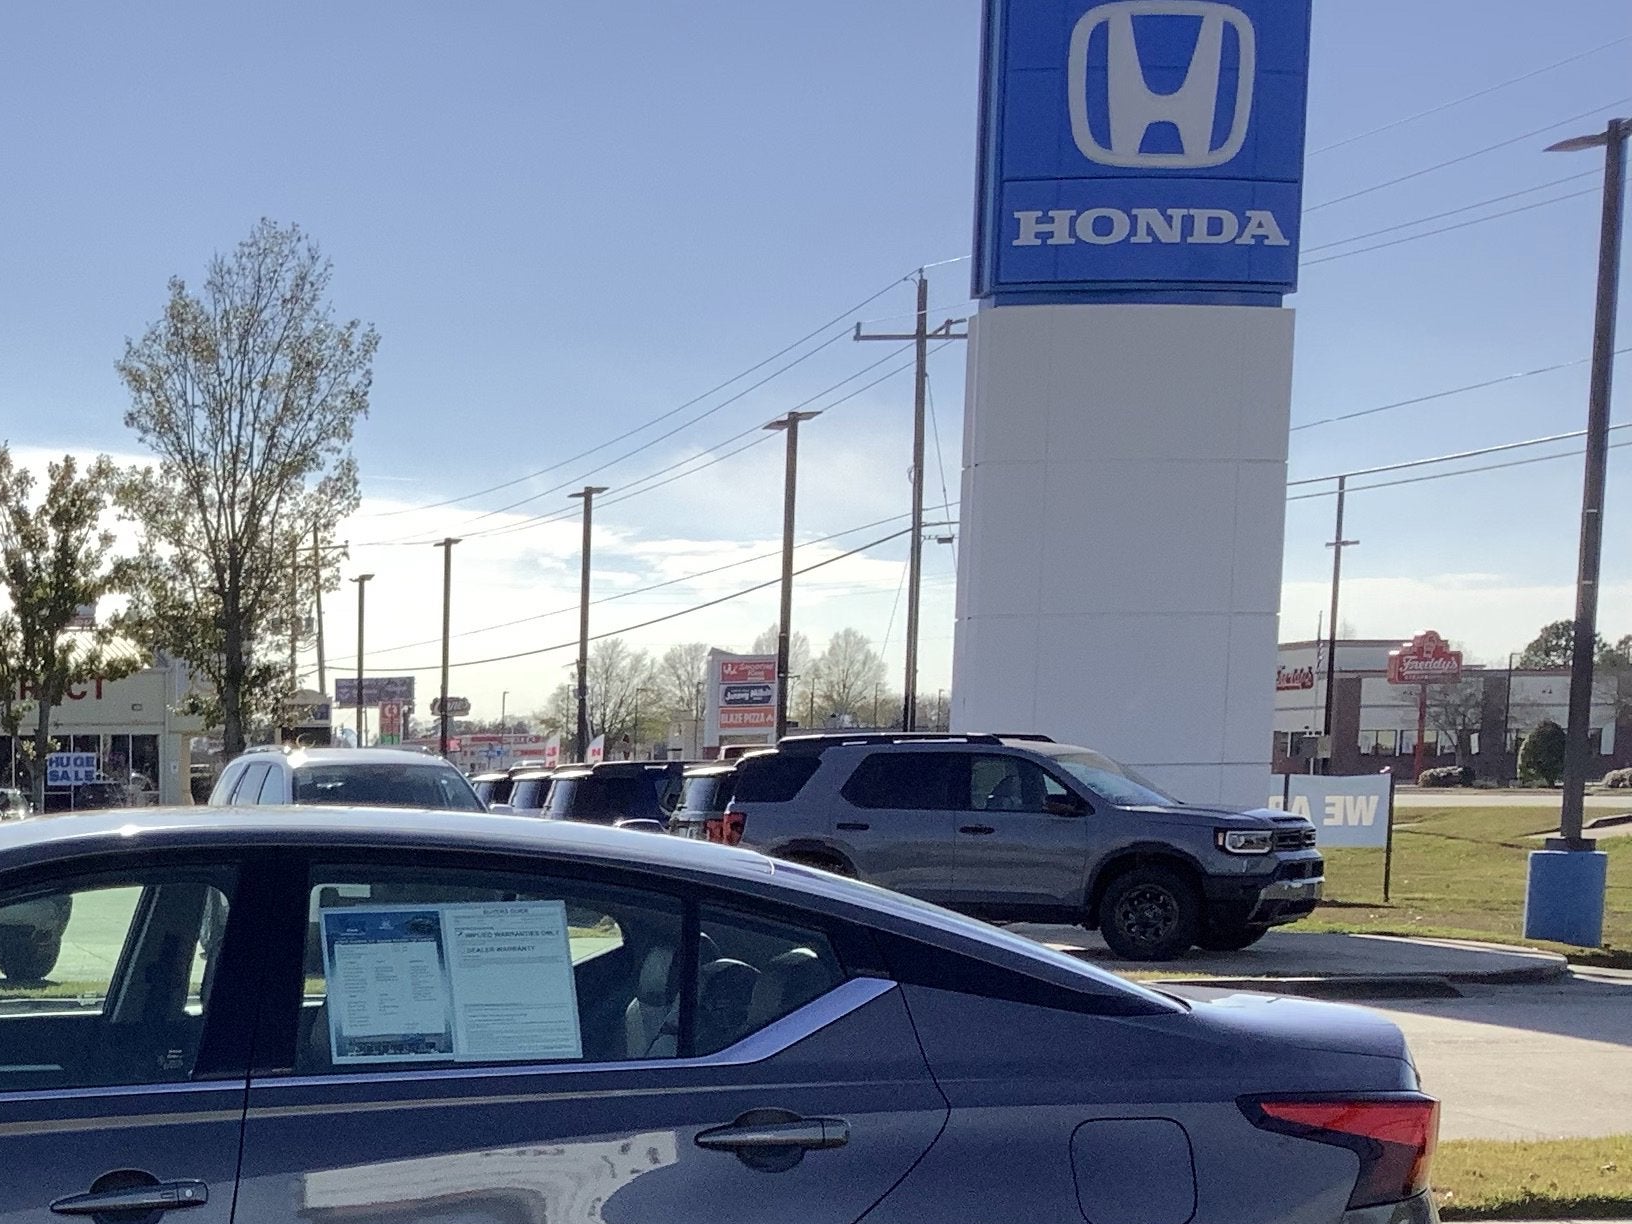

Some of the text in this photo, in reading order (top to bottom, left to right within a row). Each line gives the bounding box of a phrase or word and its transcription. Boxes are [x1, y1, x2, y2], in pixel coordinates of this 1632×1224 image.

[1012, 208, 1290, 247] HONDA
[1399, 655, 1459, 673] Freddy's
[744, 712, 765, 723] PIZZA
[48, 756, 95, 767] HUGE
[48, 769, 95, 782] SALE
